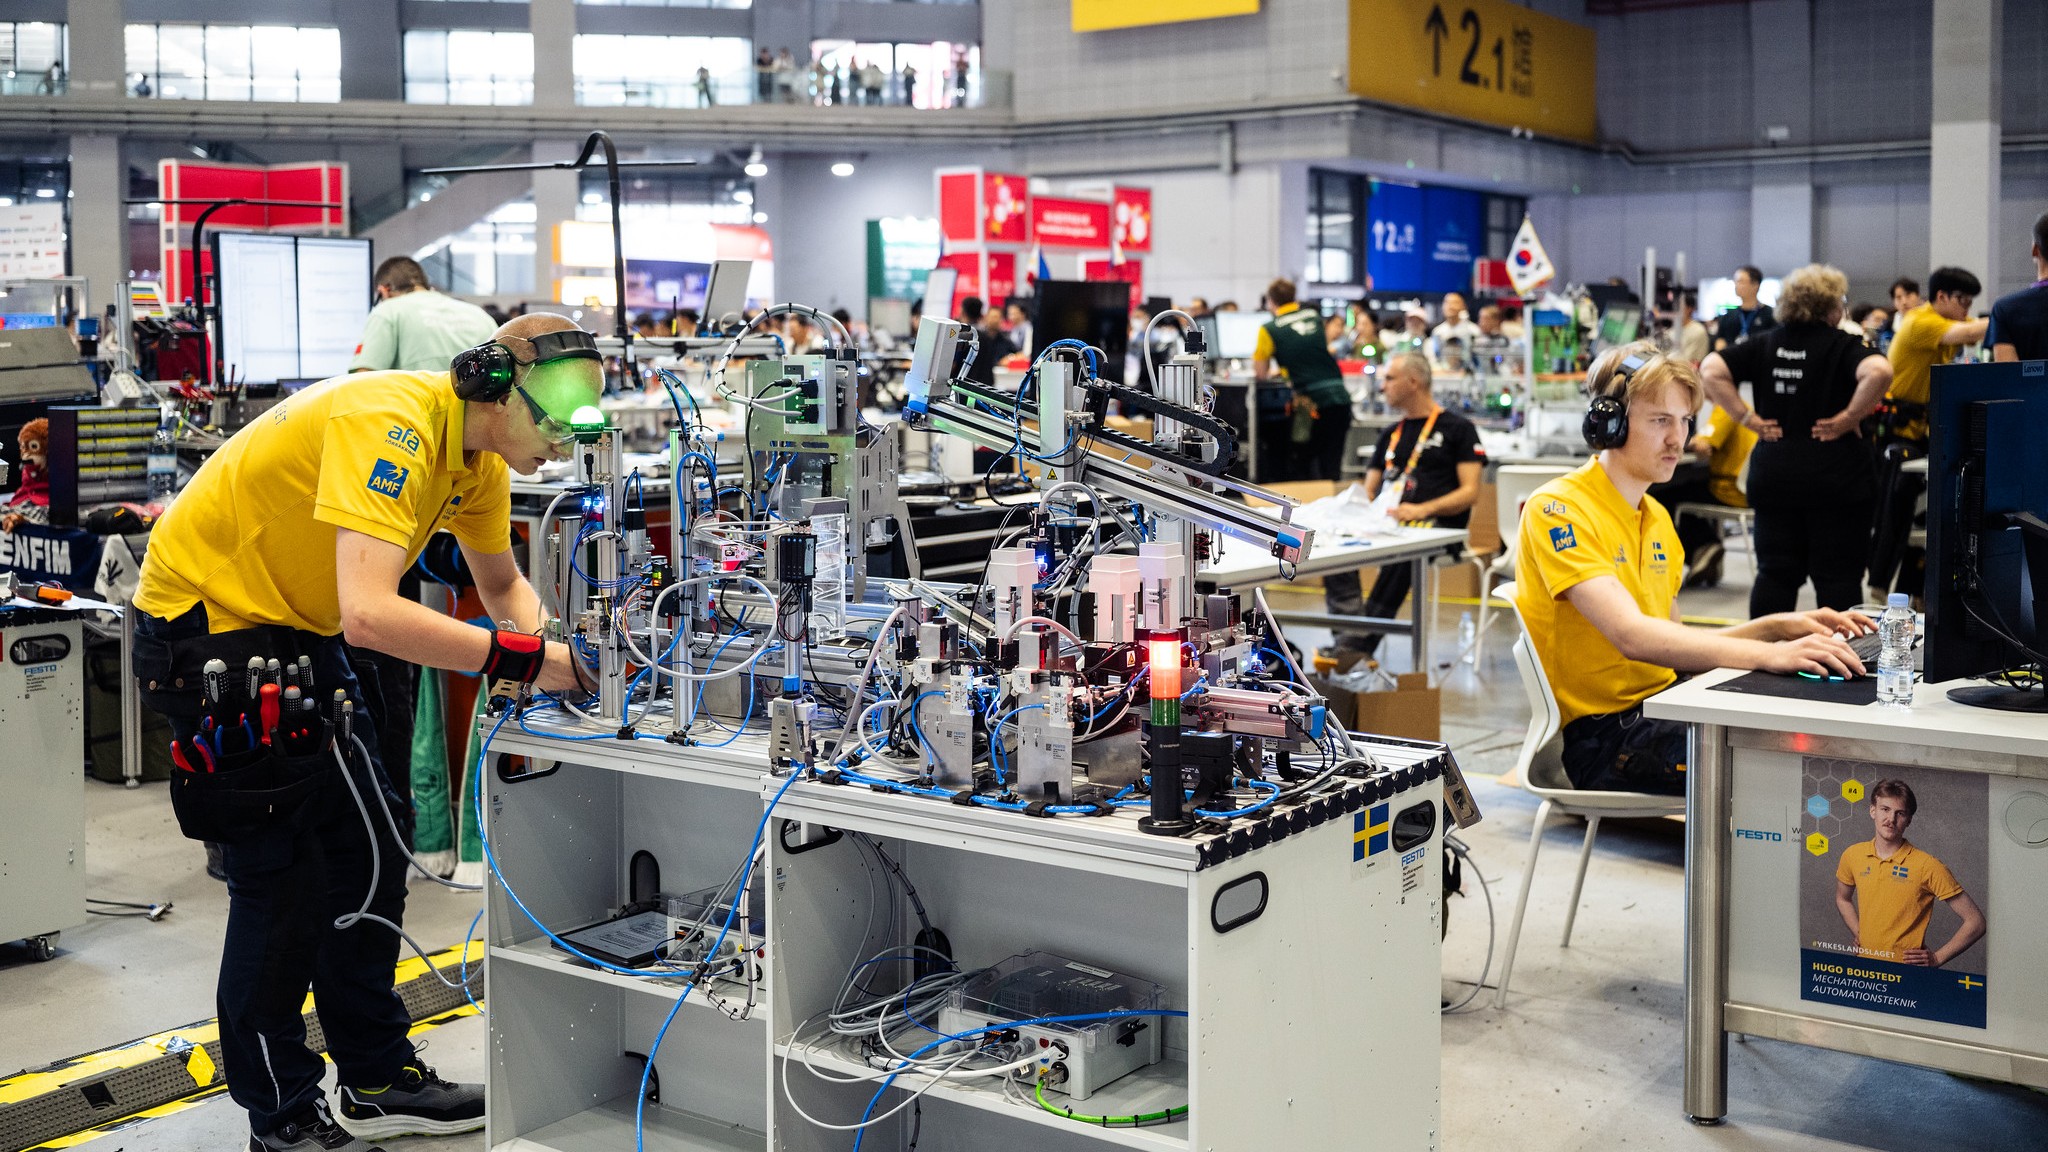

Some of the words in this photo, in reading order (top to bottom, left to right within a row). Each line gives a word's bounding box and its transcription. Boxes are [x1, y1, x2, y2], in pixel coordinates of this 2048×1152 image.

[1460, 8, 1505, 93] 2.1
[1776, 347, 1806, 360] Expert
[1772, 367, 1803, 379] FESTO
[2023, 364, 2043, 373] Lenovo
[387, 425, 420, 453] afa
[371, 475, 400, 494] AMF
[1543, 500, 1566, 514] afa
[1555, 536, 1574, 551] AMF
[24, 664, 57, 675] FESTO
[1848, 787, 1858, 795] #4
[1736, 828, 1782, 842] FESTO
[1401, 847, 1425, 866] FESTO
[1812, 940, 1896, 958] #YRKESLANDSLAGET
[1812, 962, 1843, 974] HUGO
[1847, 967, 1902, 983] BOUSTEDT
[1812, 973, 1888, 993] MECHATRONICS
[1811, 985, 1918, 1009] AUTOMATIONSTEKNIK
